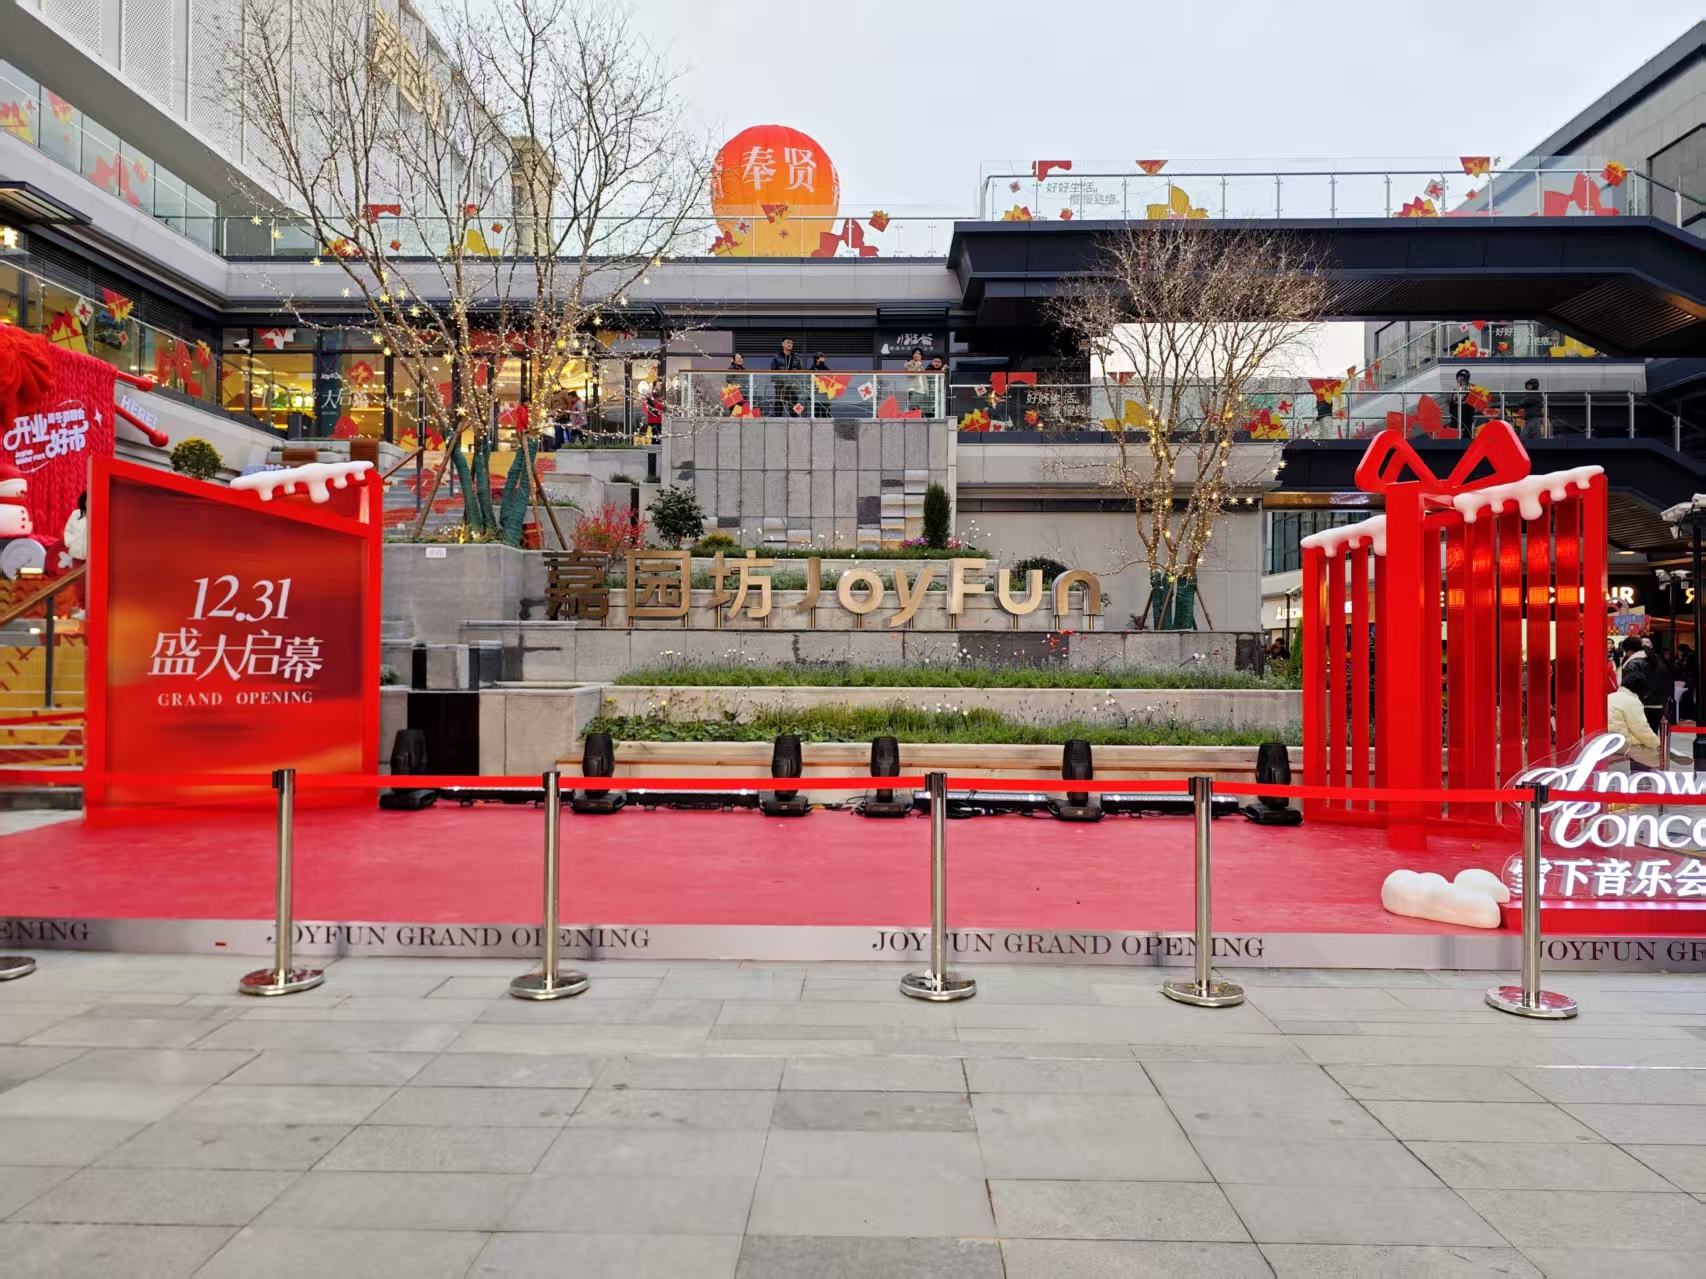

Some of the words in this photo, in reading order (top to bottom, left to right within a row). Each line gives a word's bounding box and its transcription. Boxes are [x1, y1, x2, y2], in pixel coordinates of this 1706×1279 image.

[741, 145, 817, 193] 奉贤
[120, 395, 159, 430] HERE!
[3, 413, 50, 451] 开业
[187, 574, 292, 622] 12.31
[543, 549, 774, 619] 嘉园坊
[796, 556, 1104, 628] JoyFun
[147, 627, 323, 683] 盛大启幕
[157, 692, 223, 707] GRAND
[235, 690, 313, 705] OPENING
[396, 926, 502, 948] GRAND
[871, 931, 995, 952] JOYUN
[1004, 932, 1112, 955] GRAND
